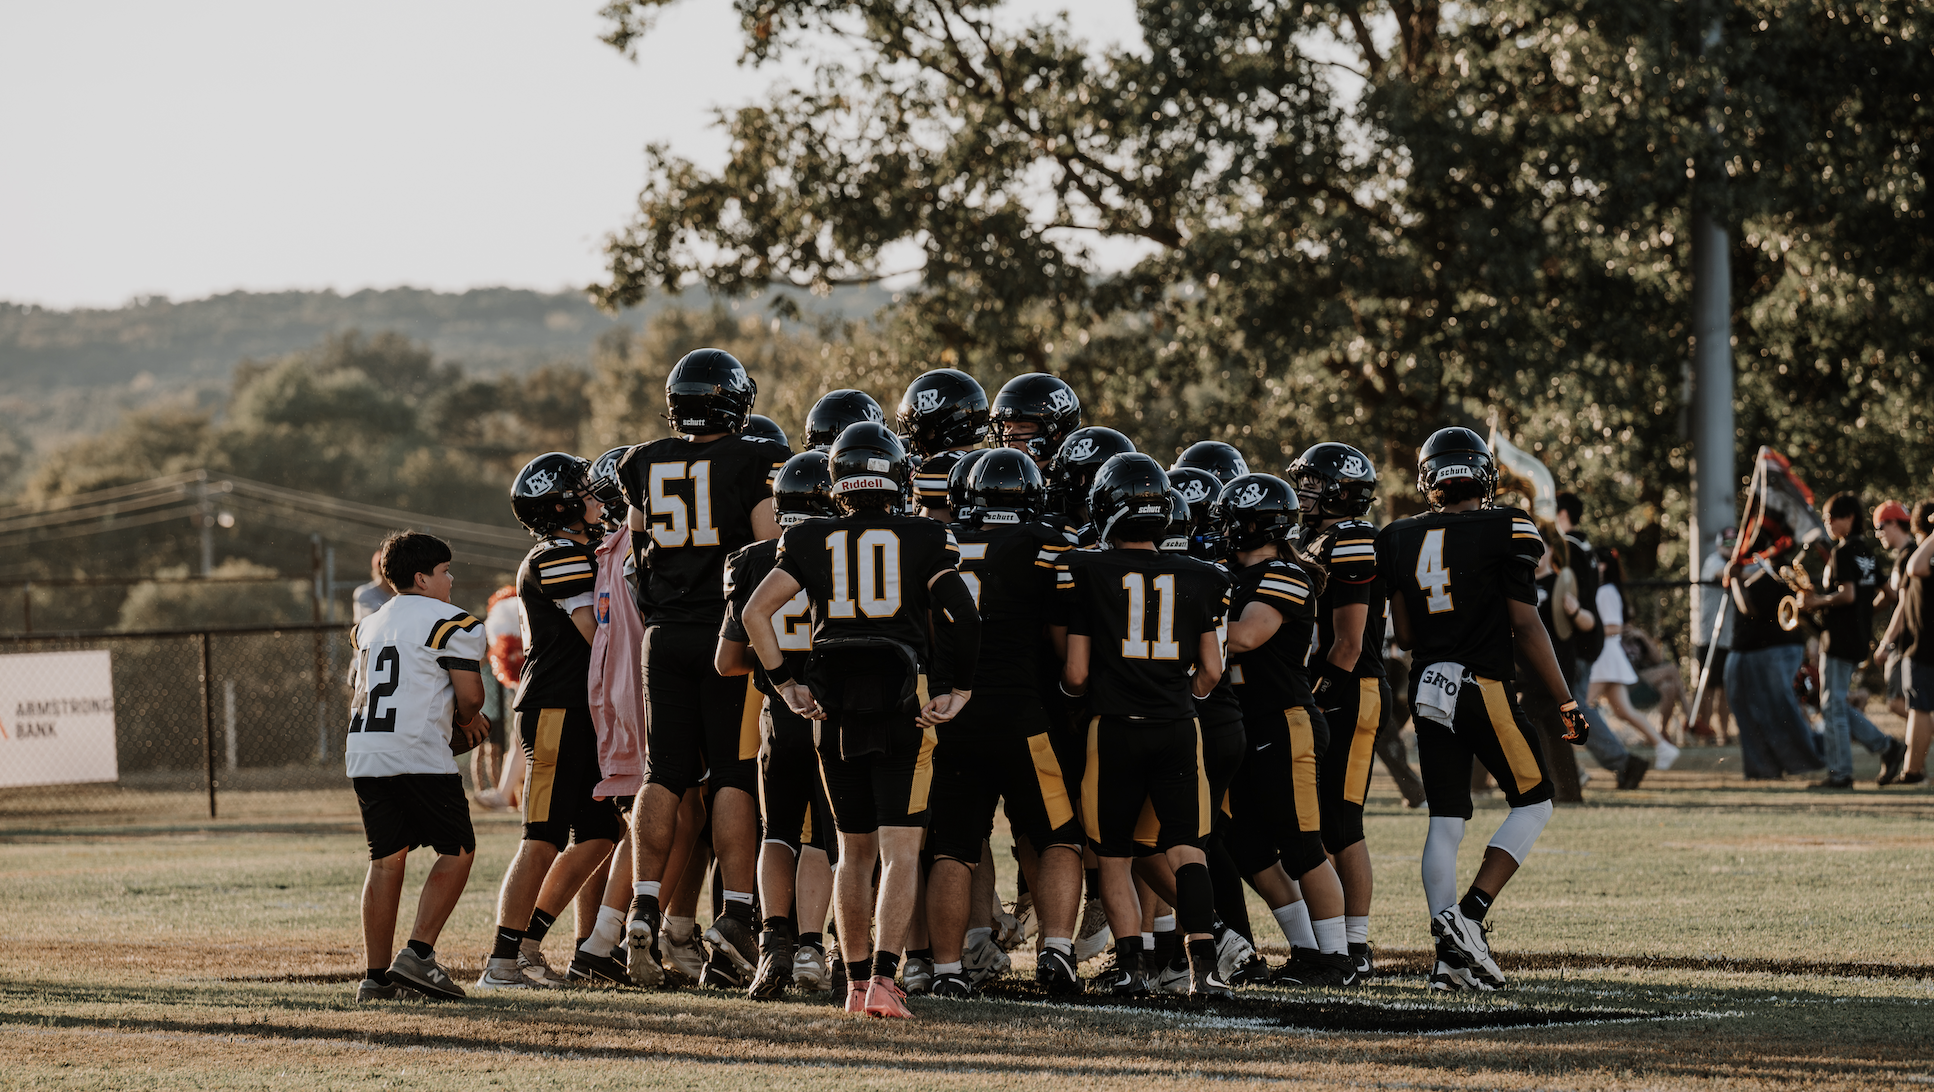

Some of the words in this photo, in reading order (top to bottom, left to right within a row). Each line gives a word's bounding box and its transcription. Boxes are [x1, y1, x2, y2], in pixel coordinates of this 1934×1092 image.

[682, 418, 706, 427] schutt
[1440, 467, 1469, 478] schutt
[841, 478, 883, 491] Riddell
[649, 460, 720, 548] 51
[1138, 504, 1162, 514] schutt
[988, 513, 1014, 521] schutt
[825, 528, 902, 618] 10
[1415, 527, 1454, 614] 4
[769, 587, 813, 651] 2
[1121, 571, 1180, 660] 11
[16, 700, 114, 716] ARMSTRONG
[16, 721, 57, 739] BANK
